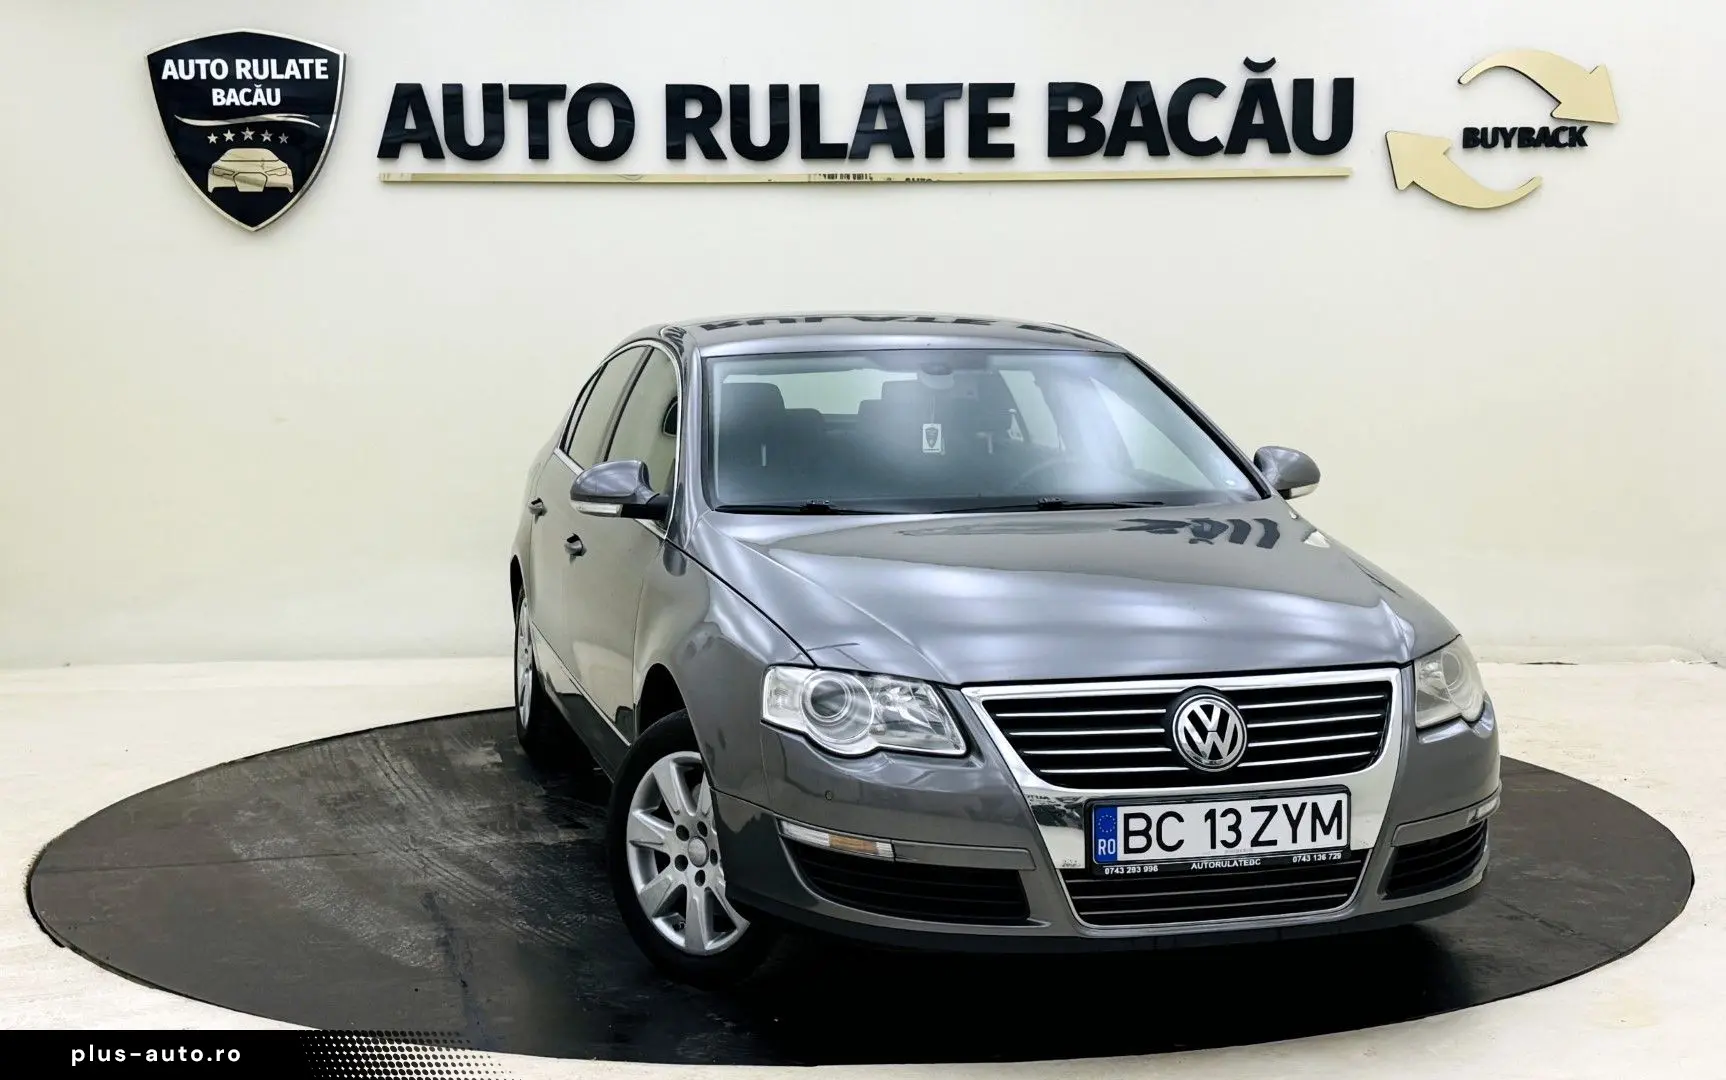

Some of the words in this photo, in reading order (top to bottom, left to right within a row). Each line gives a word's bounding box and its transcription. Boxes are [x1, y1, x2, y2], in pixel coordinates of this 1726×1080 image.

[161, 58, 229, 80] AUTO
[235, 58, 329, 80] RULATE
[212, 83, 281, 106] BACĂU
[377, 82, 636, 161] AUTO
[665, 82, 1016, 161] RULATE
[1047, 56, 1355, 159] BACĂU
[1462, 125, 1589, 149] BUYBACK
[1122, 810, 1185, 855] BC
[1097, 838, 1116, 856] RO
[1104, 867, 1125, 875] 0743
